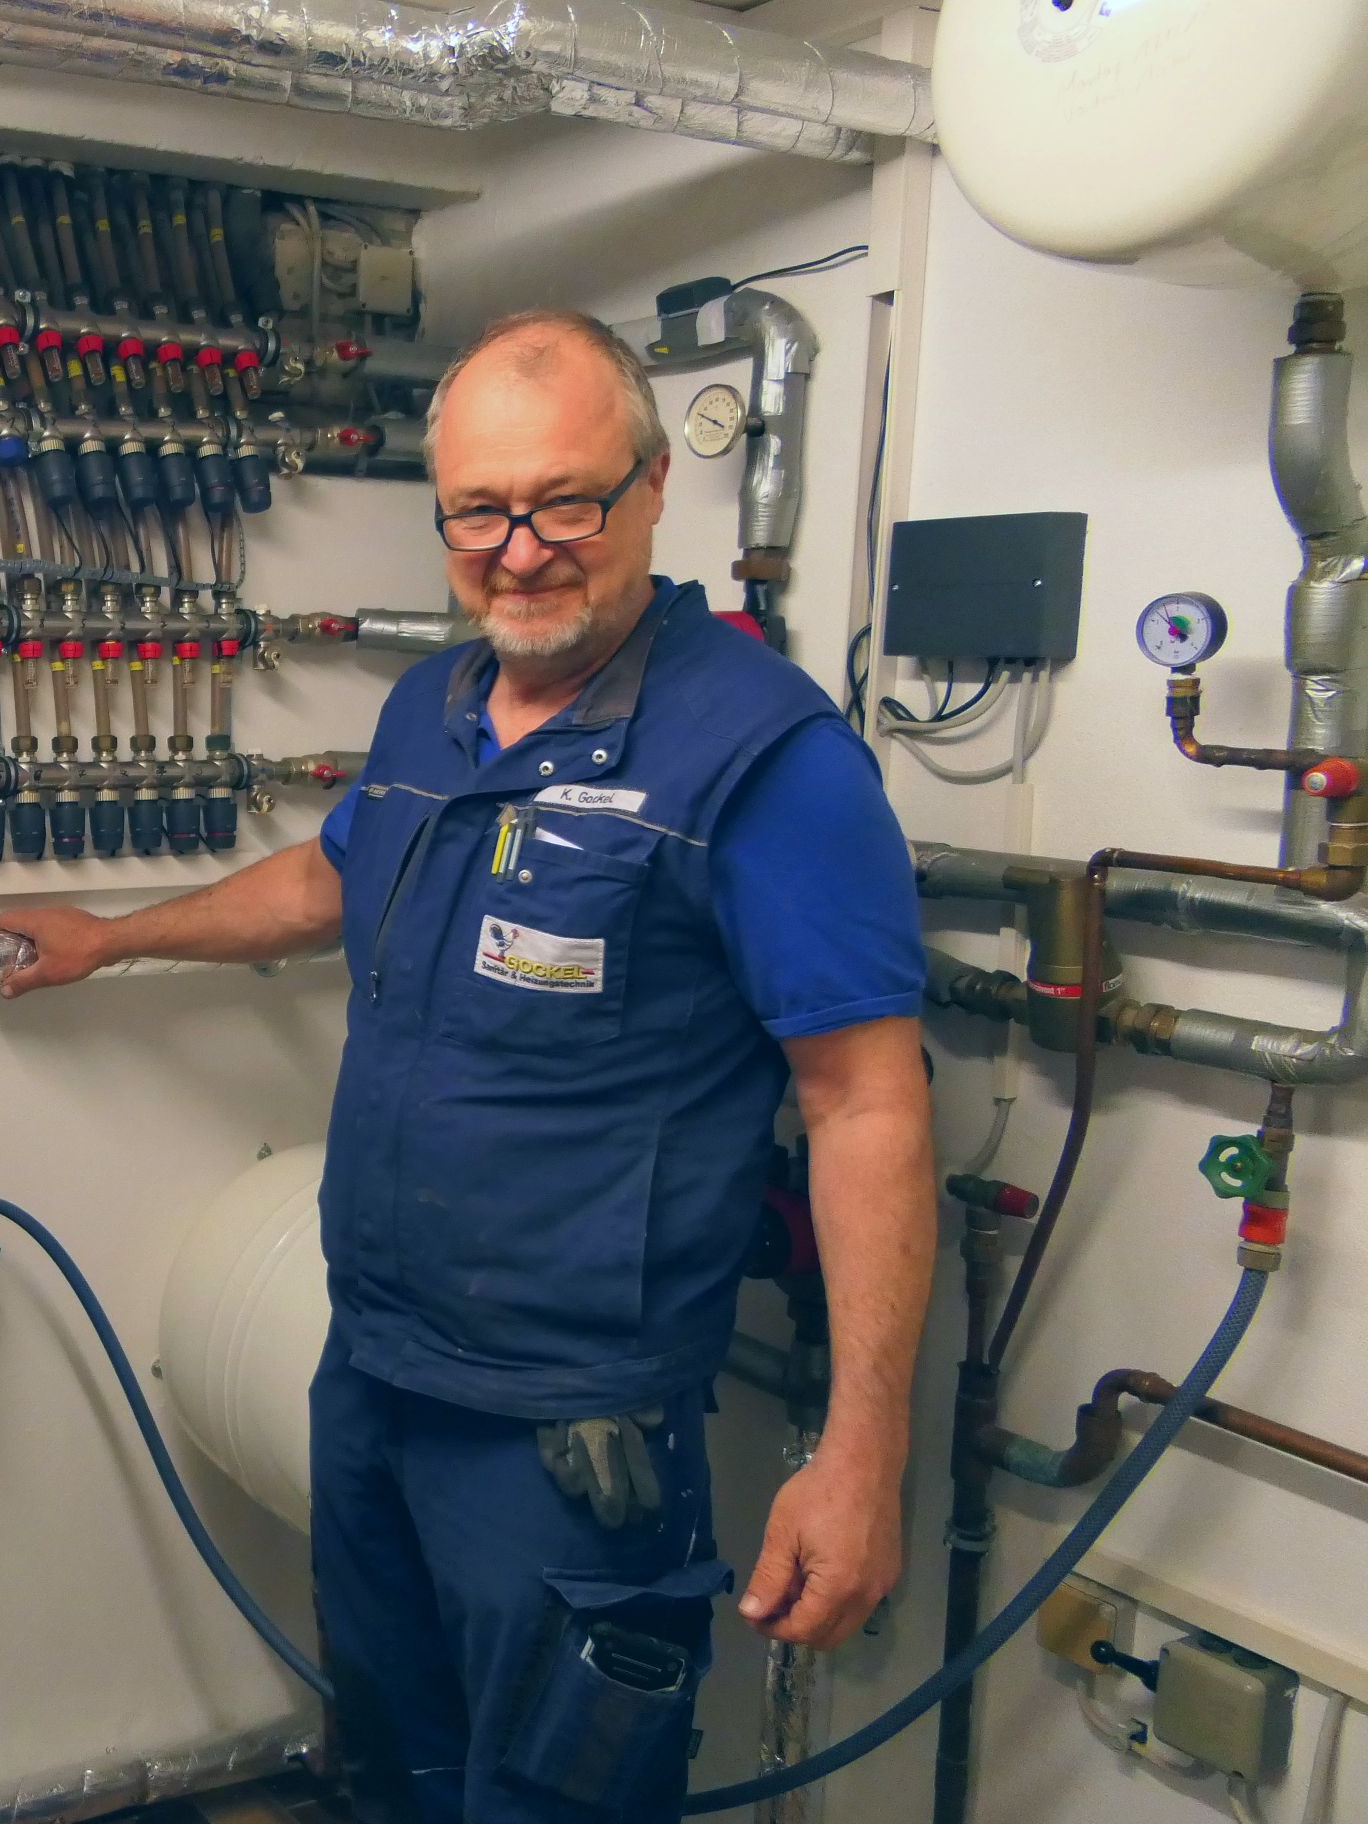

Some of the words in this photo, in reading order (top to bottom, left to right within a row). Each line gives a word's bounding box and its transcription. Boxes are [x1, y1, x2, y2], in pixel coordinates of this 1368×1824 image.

[560, 788, 572, 801] K.
[481, 960, 509, 977] Sanitär
[511, 971, 518, 980] &
[519, 972, 595, 988] Heizungstechnik
[504, 954, 588, 980] GOCKEL
